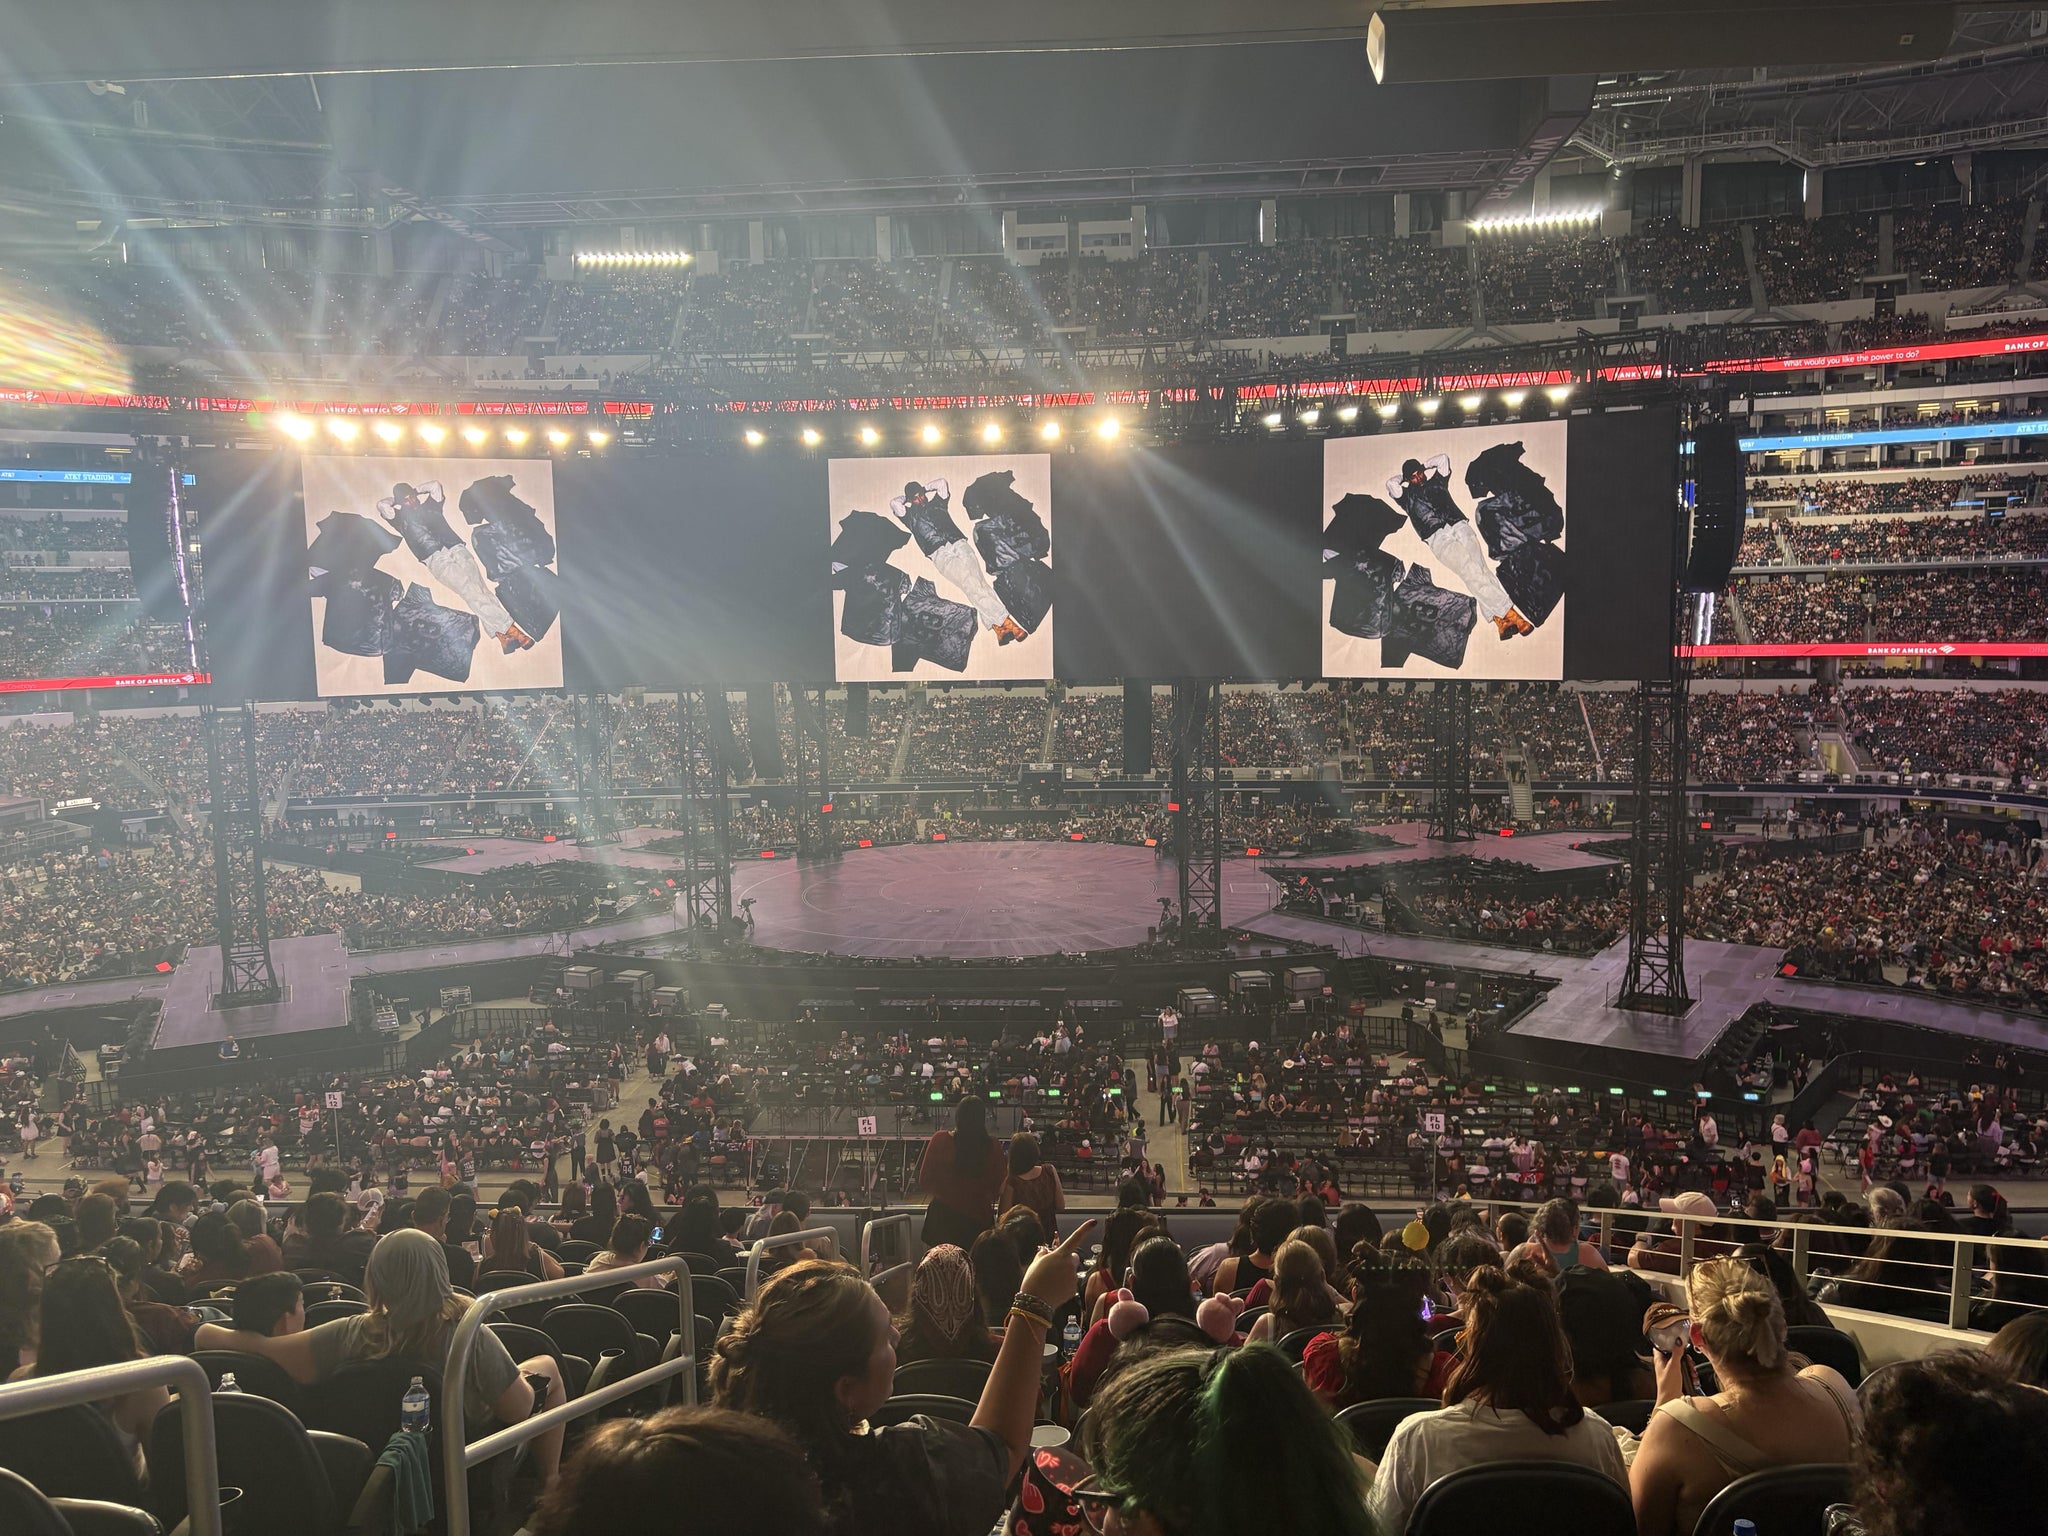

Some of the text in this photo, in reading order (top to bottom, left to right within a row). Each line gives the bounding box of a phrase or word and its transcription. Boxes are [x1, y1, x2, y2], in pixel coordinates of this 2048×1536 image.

[1486, 136, 1563, 200] WINSTAR
[2004, 343, 2030, 351] BANK
[1804, 357, 1825, 366] would
[1827, 358, 1841, 367] you
[1842, 354, 1855, 363] like
[1856, 354, 1869, 362] the
[1870, 354, 1893, 362] power
[1905, 350, 1920, 359] do?
[2016, 424, 2036, 433] AT&T
[64, 473, 81, 481] AT&T
[82, 474, 115, 482] STADIUM
